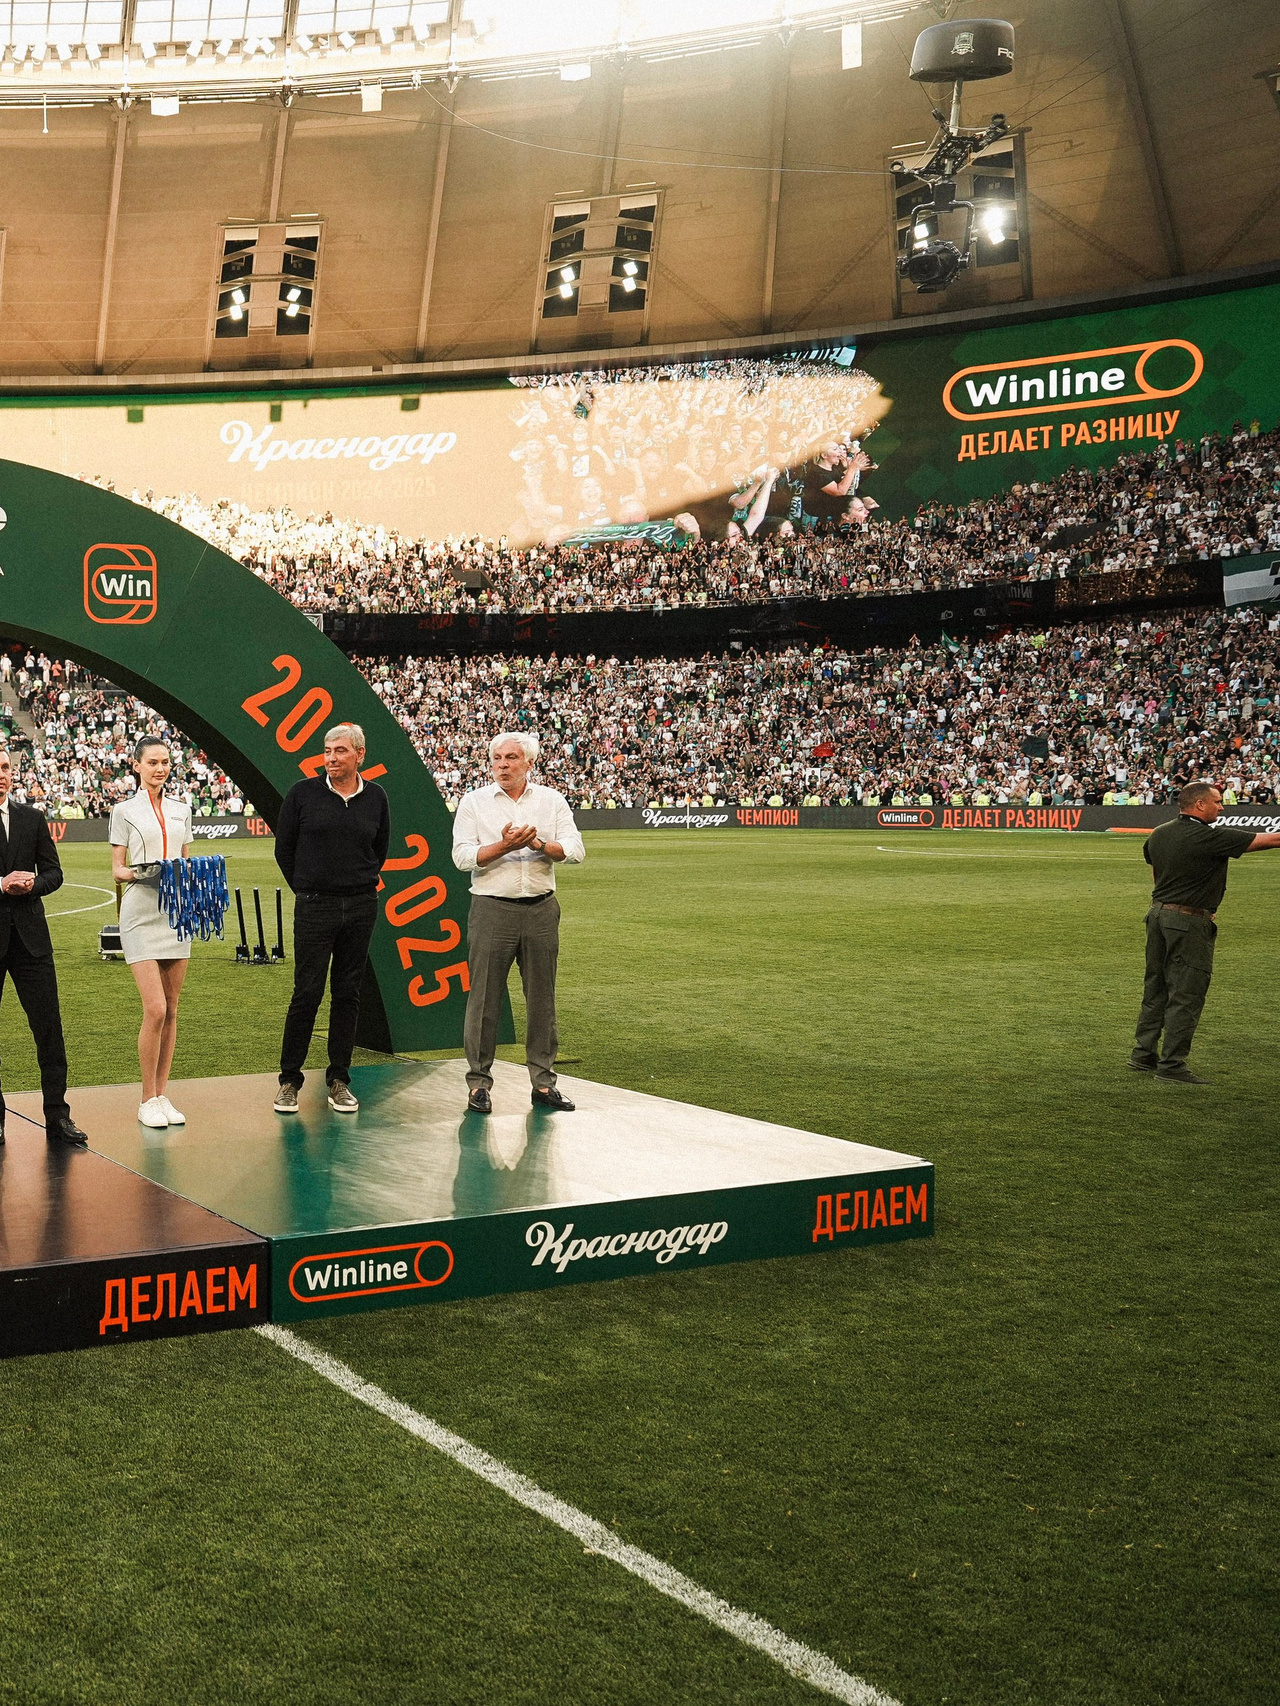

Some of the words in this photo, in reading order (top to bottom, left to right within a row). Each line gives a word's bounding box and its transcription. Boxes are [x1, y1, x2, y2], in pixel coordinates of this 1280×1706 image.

[966, 367, 1125, 407] Winline
[219, 420, 457, 471] Краснодар
[958, 426, 1053, 461] ДЕЛАЕТ
[1061, 410, 1180, 446] РАЗНИЦУ
[99, 573, 151, 598] Win
[241, 654, 388, 779] 20
[641, 808, 729, 828] Краснодар
[736, 809, 799, 826] ЧЕМПИОН
[882, 812, 919, 824] Winline
[942, 809, 1001, 829] ДЕЛАЕТ
[1005, 808, 1082, 830] РАЗНИЦУ
[375, 833, 471, 1007] 2025
[812, 1183, 927, 1243] ДЕЛАЕМ
[525, 1221, 729, 1273] Краснодар
[99, 1263, 257, 1335] ДЕЛАЕМ
[304, 1259, 408, 1291] Winline
